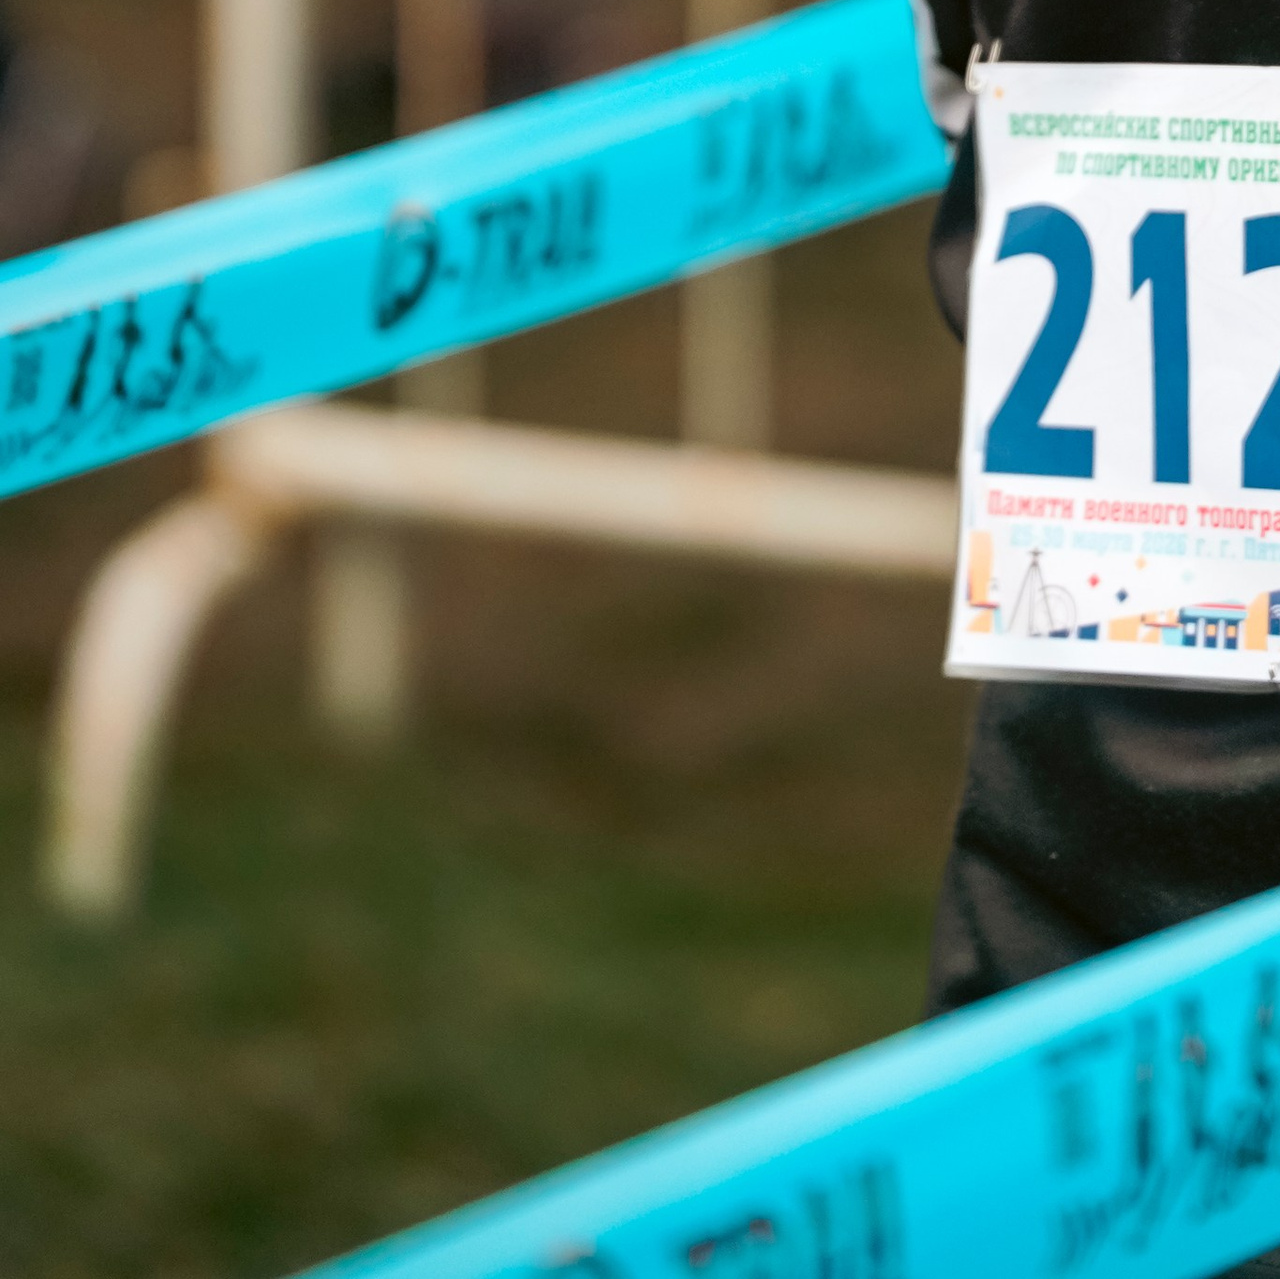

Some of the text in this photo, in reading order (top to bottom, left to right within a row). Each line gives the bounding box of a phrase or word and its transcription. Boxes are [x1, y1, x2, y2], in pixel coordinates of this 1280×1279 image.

[1008, 111, 1161, 140] ВСЕРОССИЙСКИЕ
[1055, 151, 1077, 176] ПО
[1082, 152, 1220, 181] СПОРТИВНОМУ
[988, 490, 1074, 520] Памяти
[1084, 498, 1188, 527] военного
